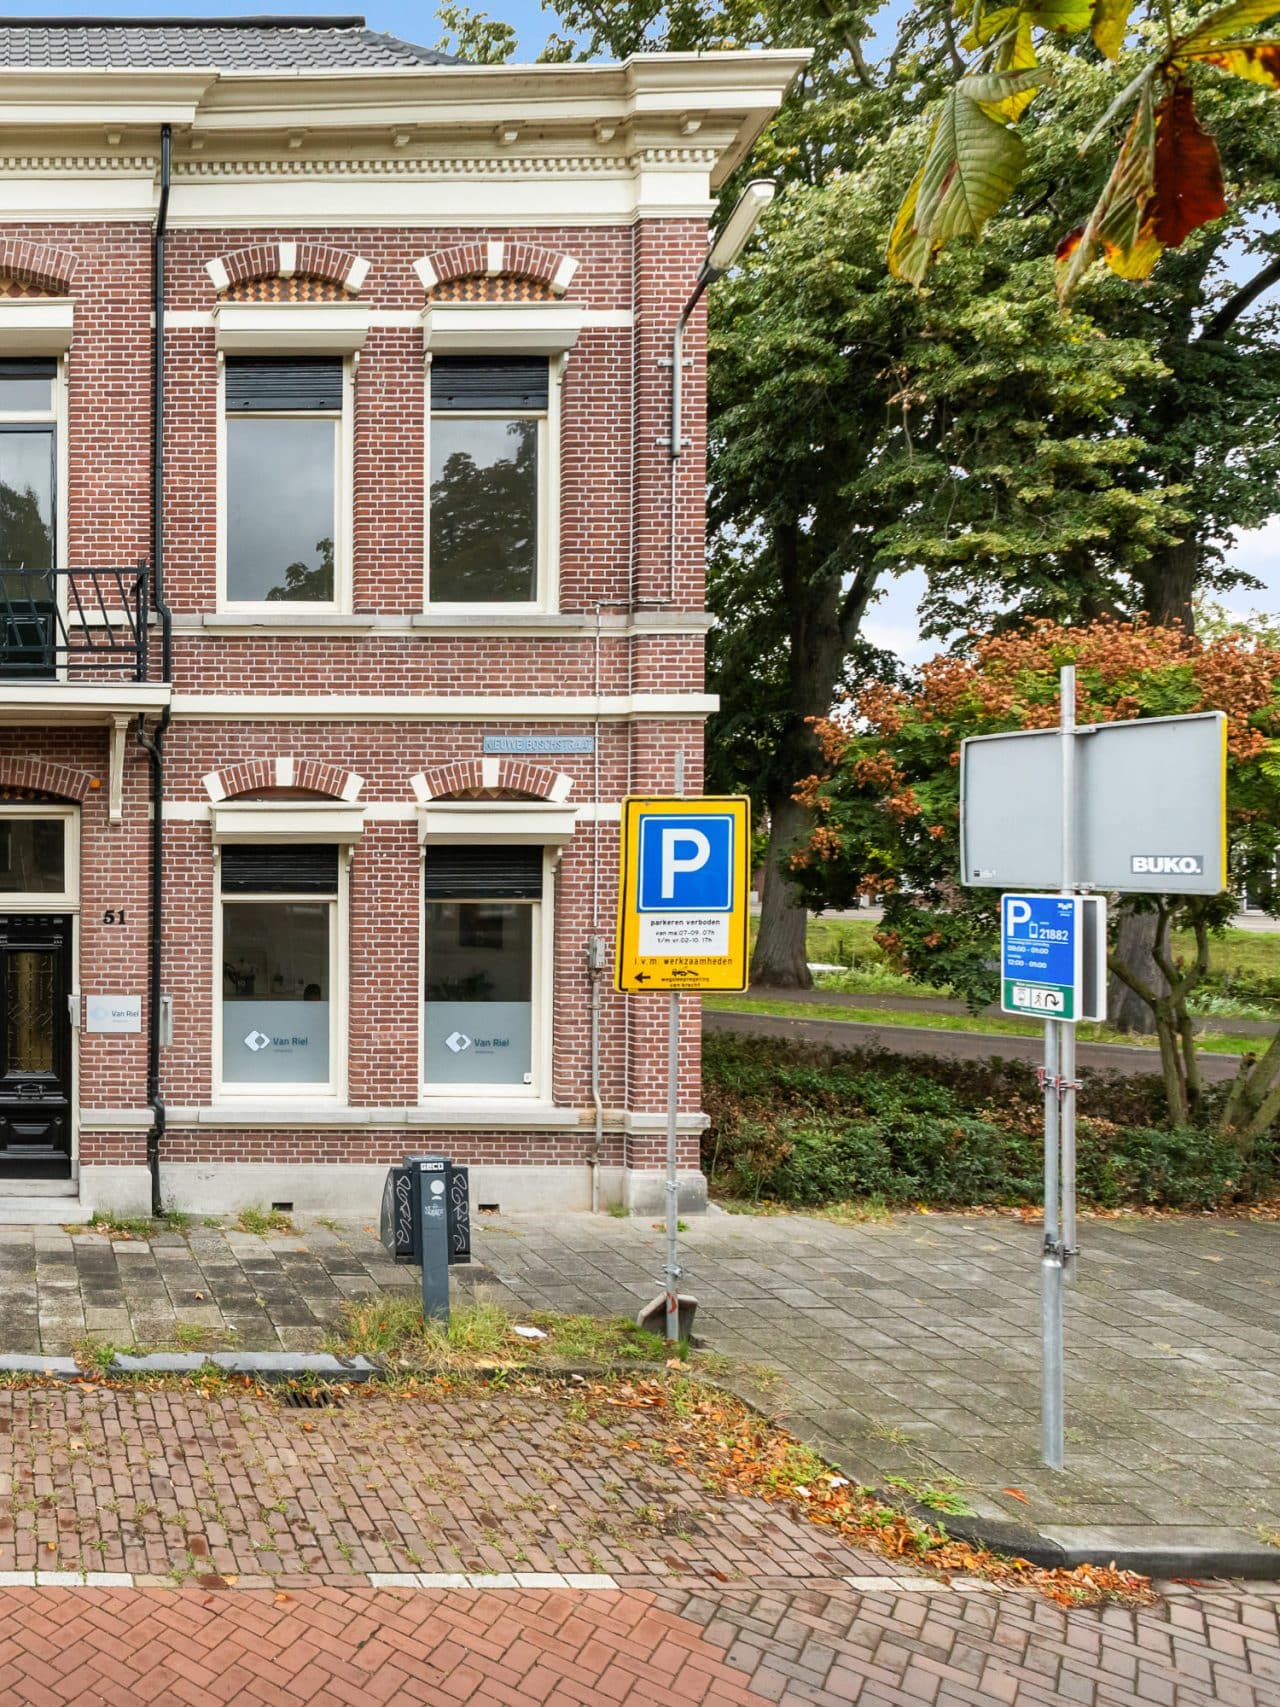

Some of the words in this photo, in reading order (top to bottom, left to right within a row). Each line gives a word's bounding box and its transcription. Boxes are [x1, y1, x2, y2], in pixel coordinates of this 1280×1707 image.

[661, 828, 711, 899] P
[102, 909, 126, 925] 51
[1007, 900, 1032, 936] P
[650, 919, 684, 927] parkeren
[1039, 928, 1069, 941] 21882
[663, 957, 733, 966] werkzaamheden
[273, 1037, 289, 1046] Van
[291, 1036, 308, 1046] Riel
[474, 1038, 491, 1047] Van
[492, 1038, 509, 1047] Riel
